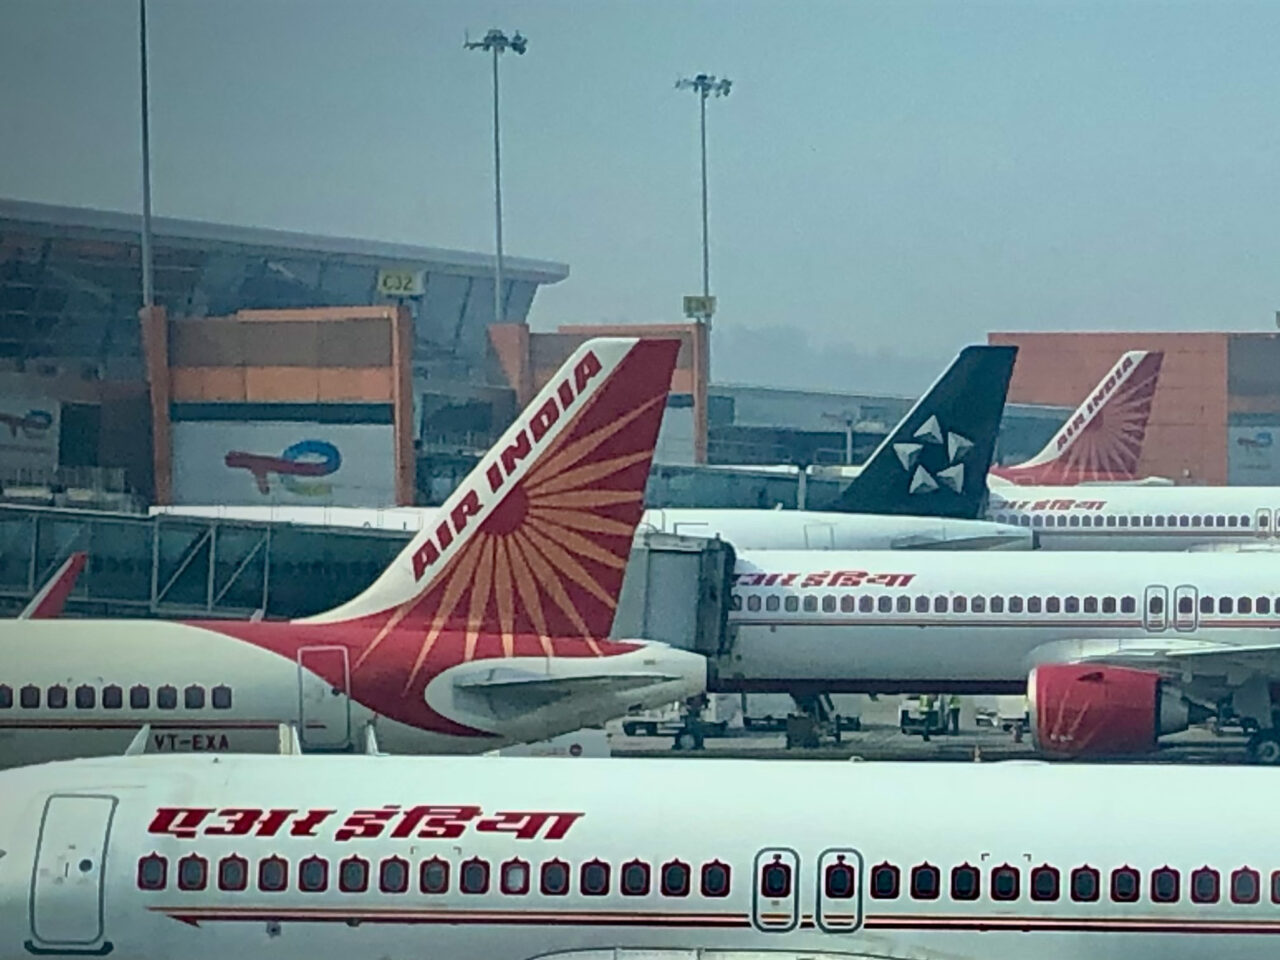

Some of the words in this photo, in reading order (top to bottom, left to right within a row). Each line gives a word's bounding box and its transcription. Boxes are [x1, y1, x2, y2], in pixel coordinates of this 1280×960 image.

[1056, 413, 1085, 452] AIR
[1087, 356, 1133, 414] INDIA
[412, 489, 484, 583] AIR
[486, 350, 603, 494] INDIA
[801, 570, 917, 589] इंडिया
[154, 733, 230, 752] VT-EXA
[147, 807, 338, 840] एअर
[334, 804, 587, 842] इंडिया
